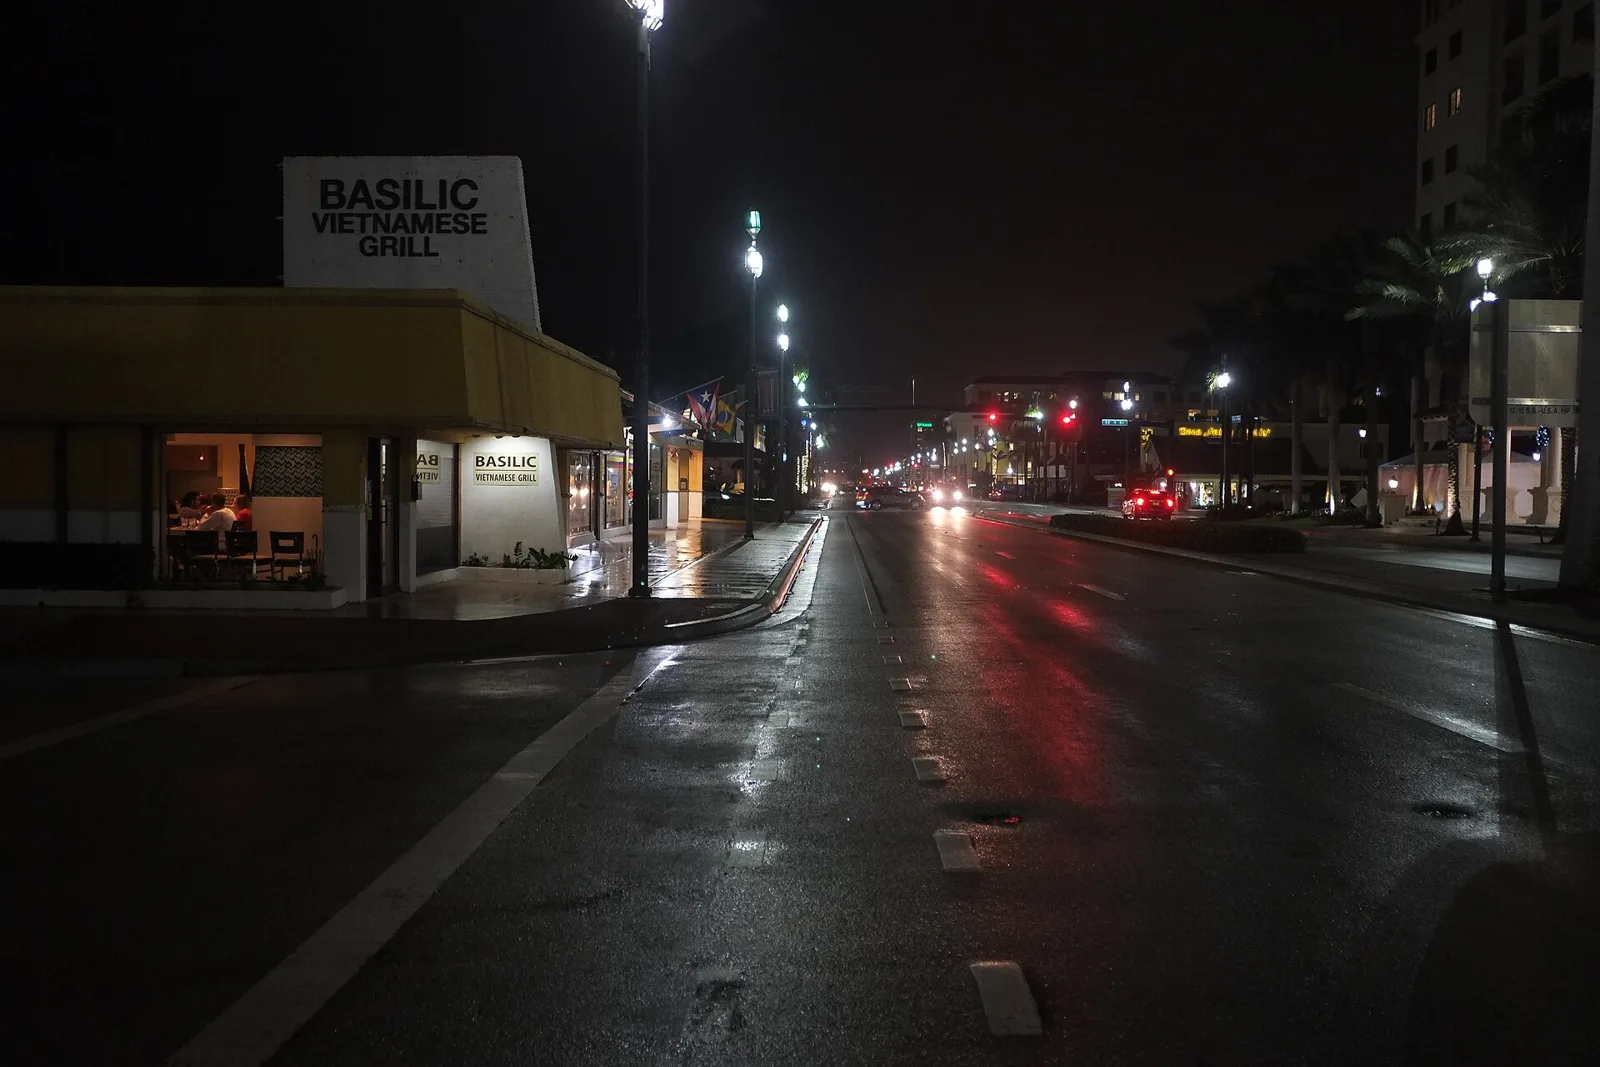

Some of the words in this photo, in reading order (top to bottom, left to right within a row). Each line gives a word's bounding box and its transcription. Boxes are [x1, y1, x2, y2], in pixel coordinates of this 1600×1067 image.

[320, 179, 479, 210] BASILIC
[312, 212, 488, 234] VIETNAMESE
[359, 235, 439, 257] GRILL
[475, 456, 537, 467] BASILIC
[475, 473, 516, 482] VIETNAMESE
[518, 474, 537, 482] GRILL
